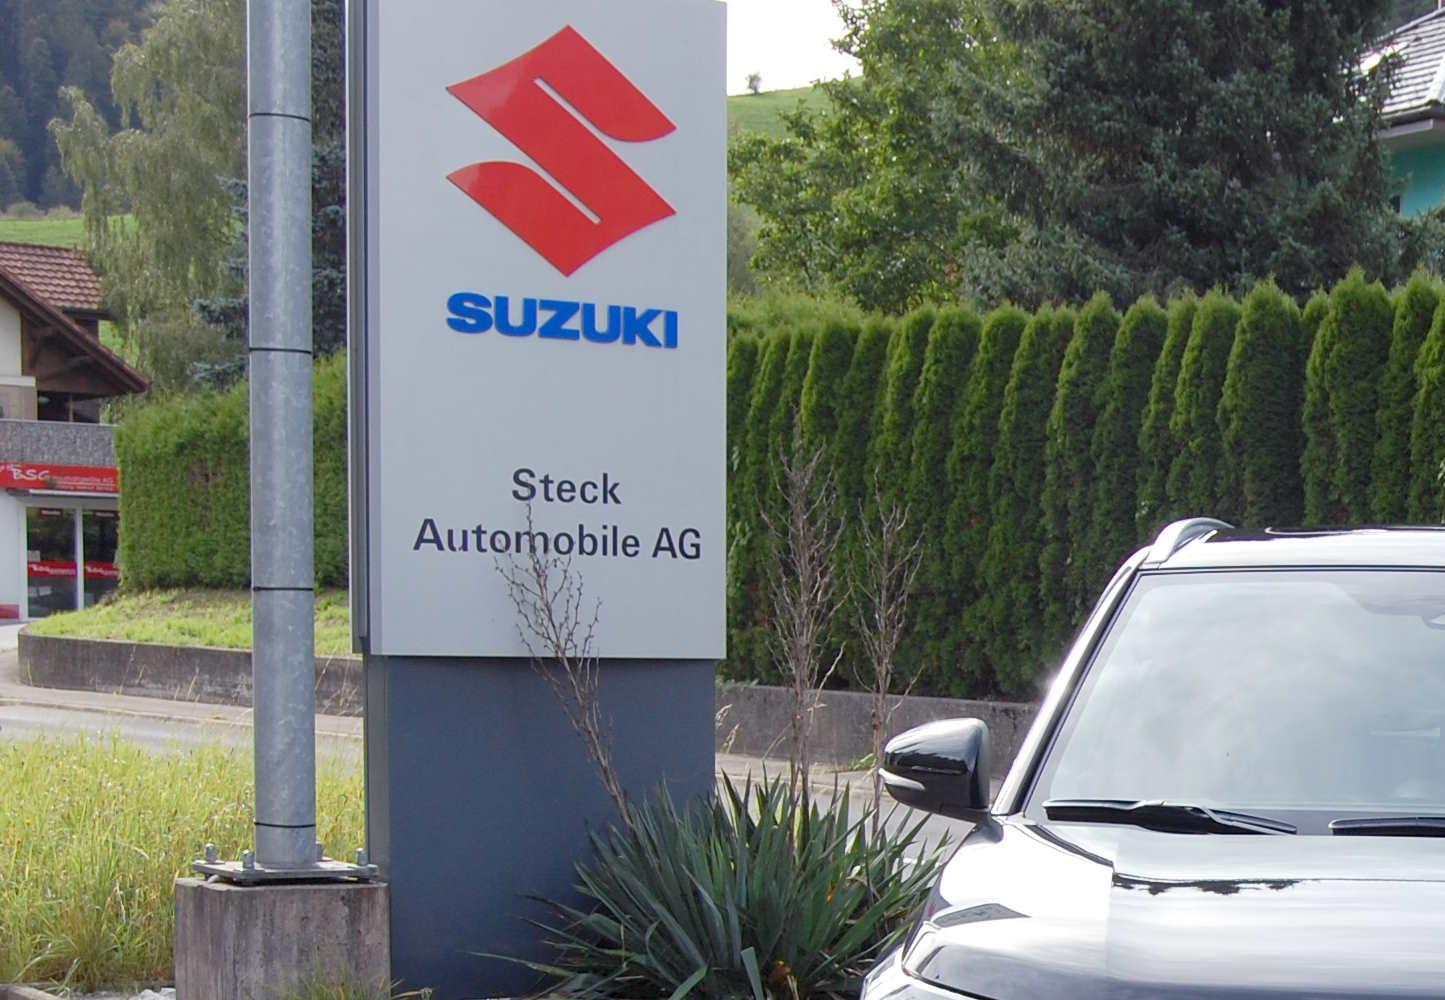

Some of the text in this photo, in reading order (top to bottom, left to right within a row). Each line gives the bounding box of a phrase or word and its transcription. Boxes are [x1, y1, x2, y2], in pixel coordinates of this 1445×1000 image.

[446, 292, 678, 349] SUZUKI
[511, 468, 621, 504] Steck
[413, 518, 701, 559] Automobile AG
